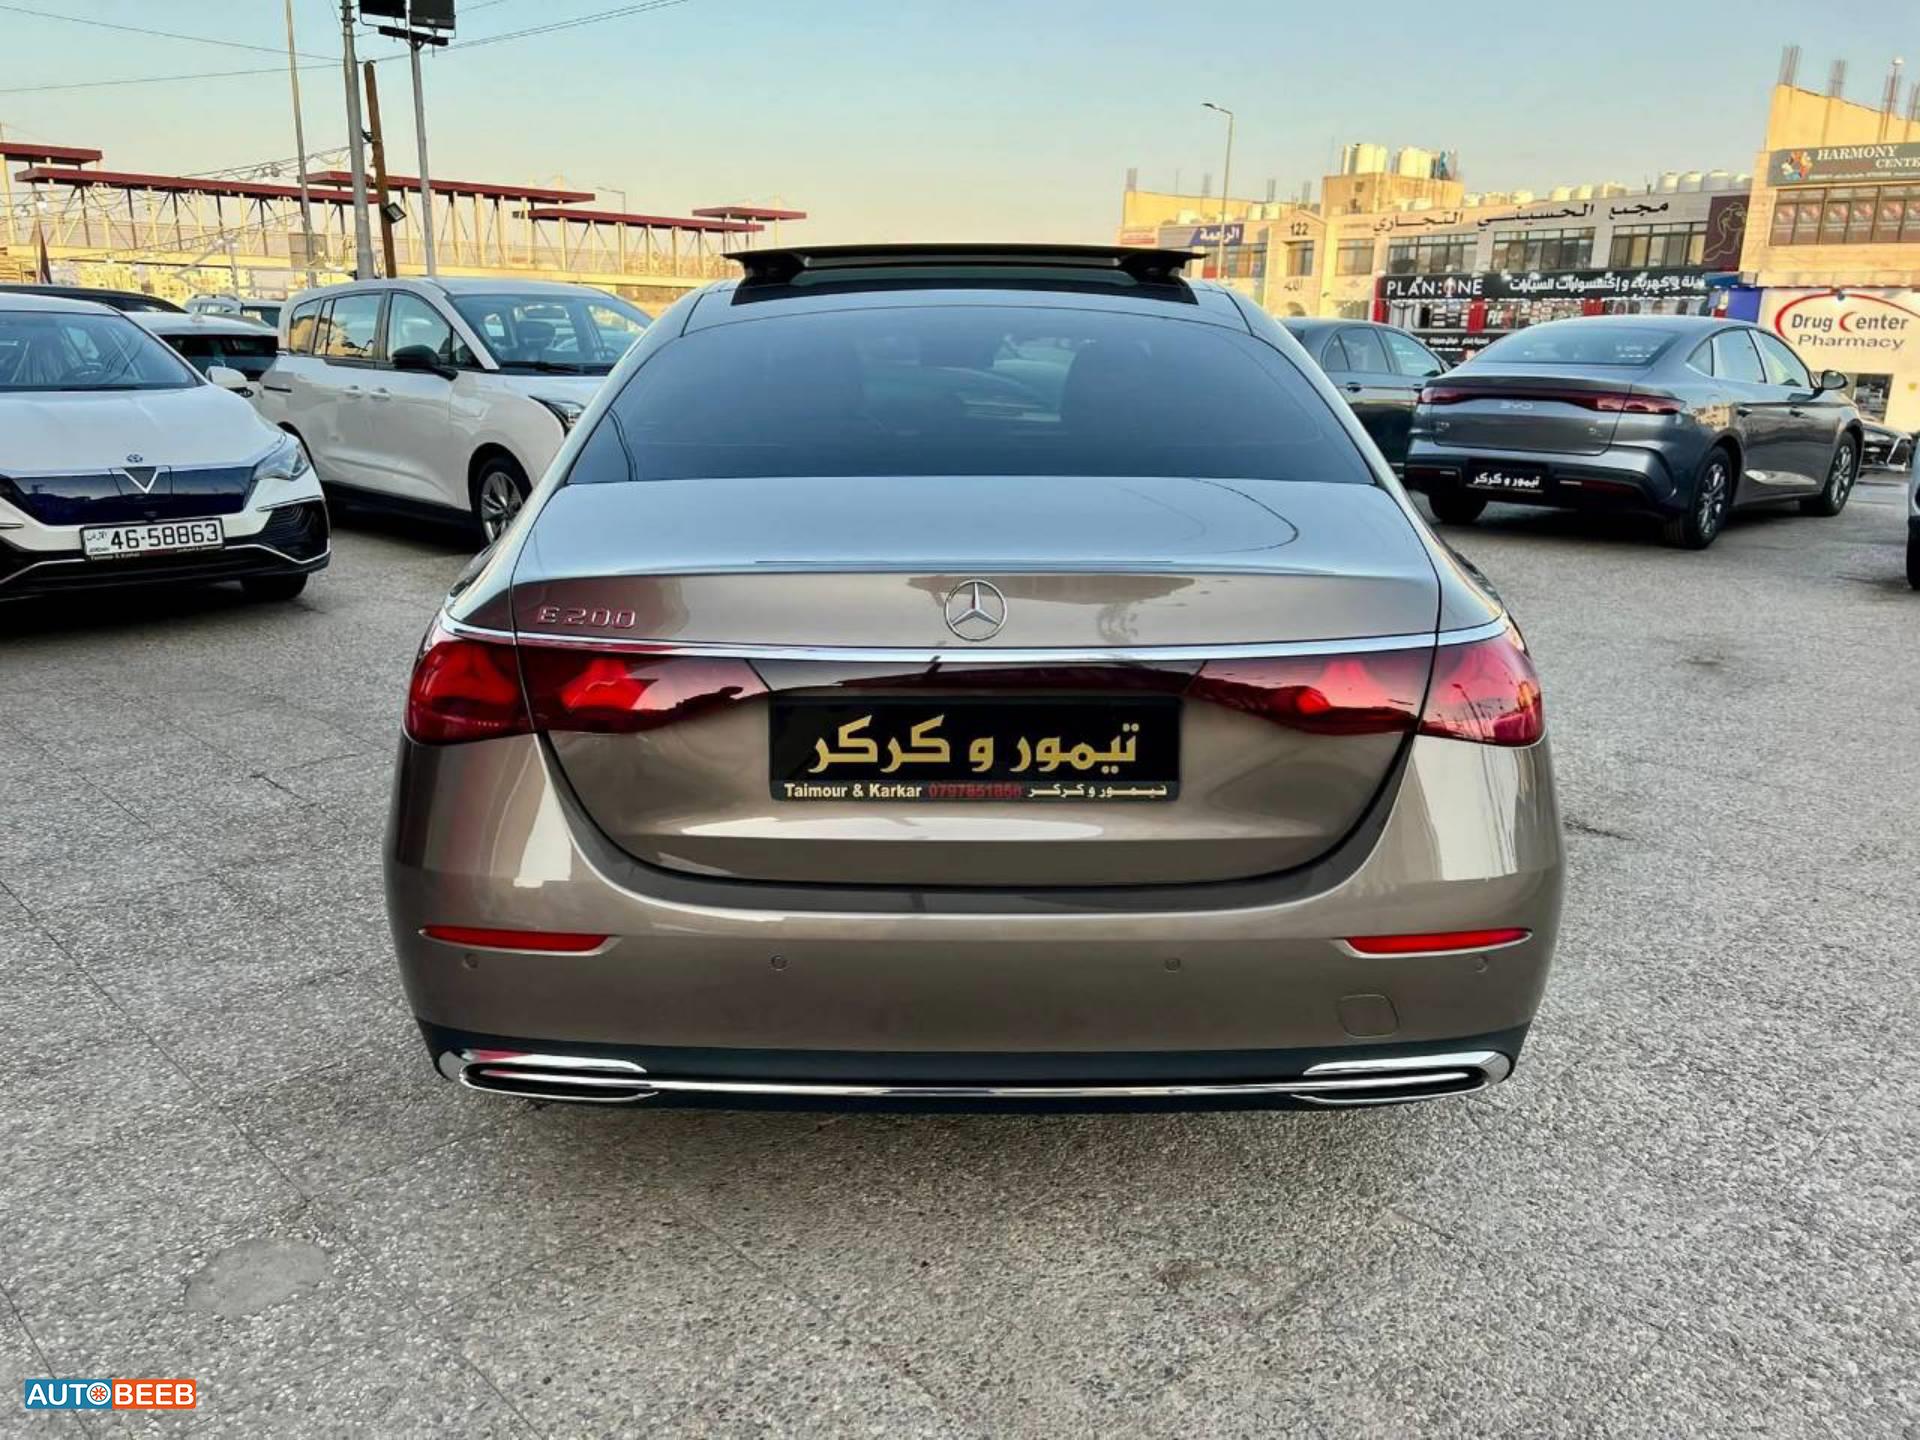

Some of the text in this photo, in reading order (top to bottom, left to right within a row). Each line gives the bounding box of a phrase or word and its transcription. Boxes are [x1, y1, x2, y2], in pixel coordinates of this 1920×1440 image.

[1816, 145, 1897, 161] HARMONY
[1373, 211, 1464, 235] التجاري
[1477, 203, 1594, 231] الحسيني
[1290, 223, 1309, 236] 122
[1791, 311, 1909, 333] Drug Center
[1798, 334, 1905, 350] Pharmacy
[111, 523, 218, 549] 46-58863
[563, 608, 637, 630] 200
[807, 714, 1140, 775] تيمور و كركر
[784, 783, 848, 798] Taimour
[852, 784, 864, 798] &
[868, 783, 922, 798] Karkar
[1028, 783, 1085, 798] كركر
